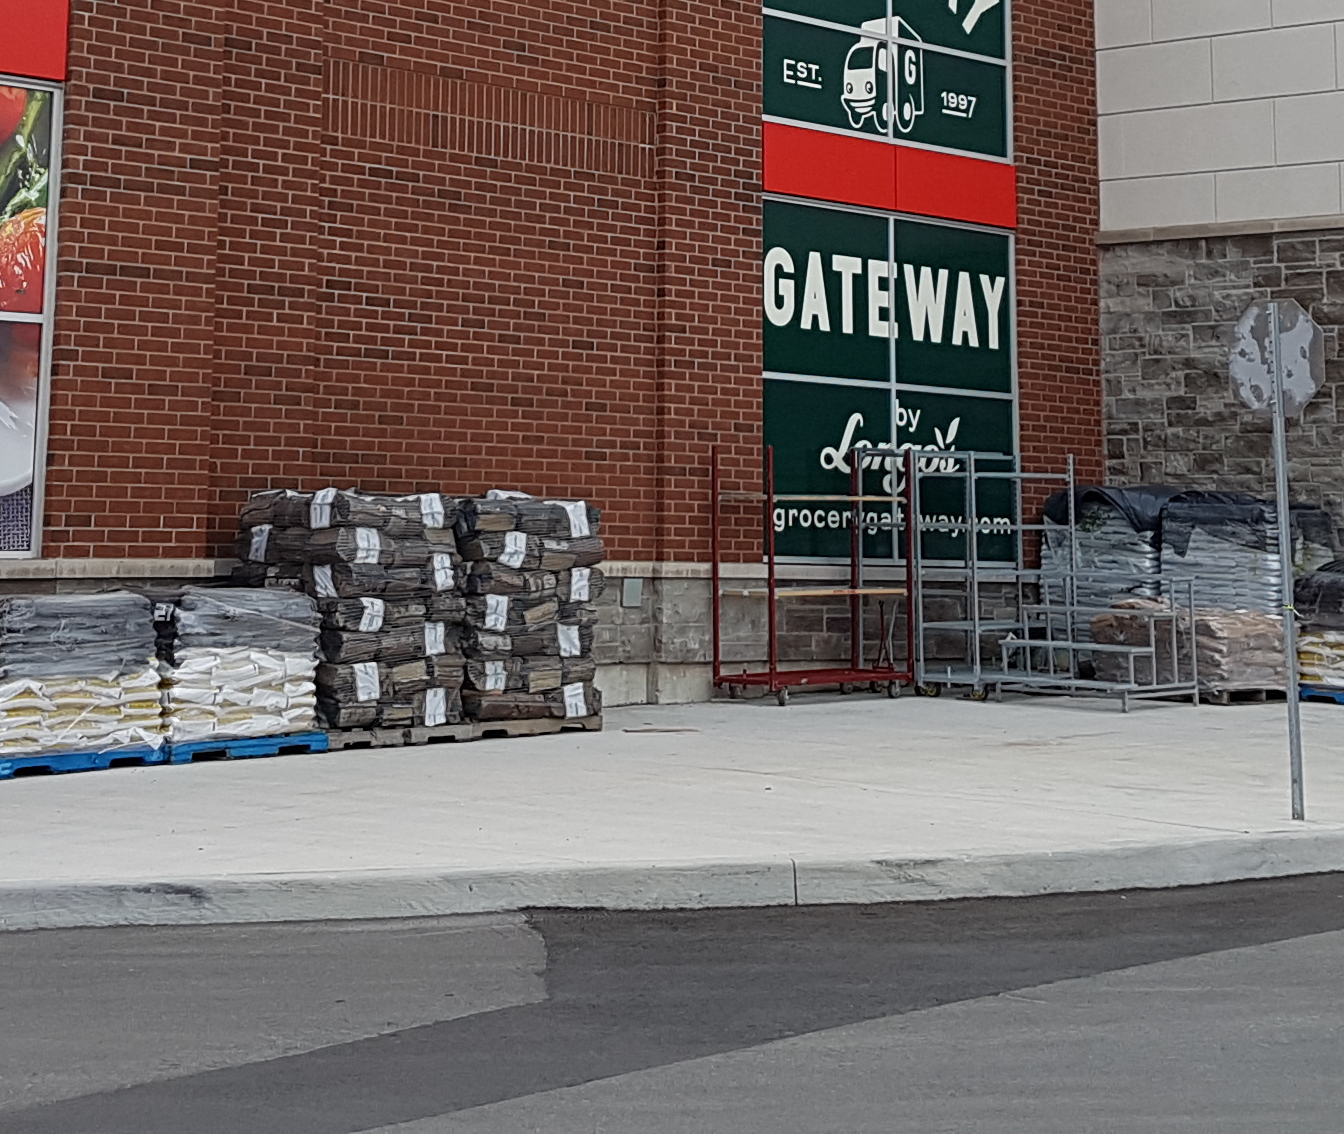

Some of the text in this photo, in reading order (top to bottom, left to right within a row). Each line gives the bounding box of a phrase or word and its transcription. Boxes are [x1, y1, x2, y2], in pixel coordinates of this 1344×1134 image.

[783, 58, 822, 89] EST.
[904, 49, 917, 85] G
[940, 91, 977, 118] 1997
[763, 247, 1006, 350] GATEWAY
[895, 399, 921, 432] by
